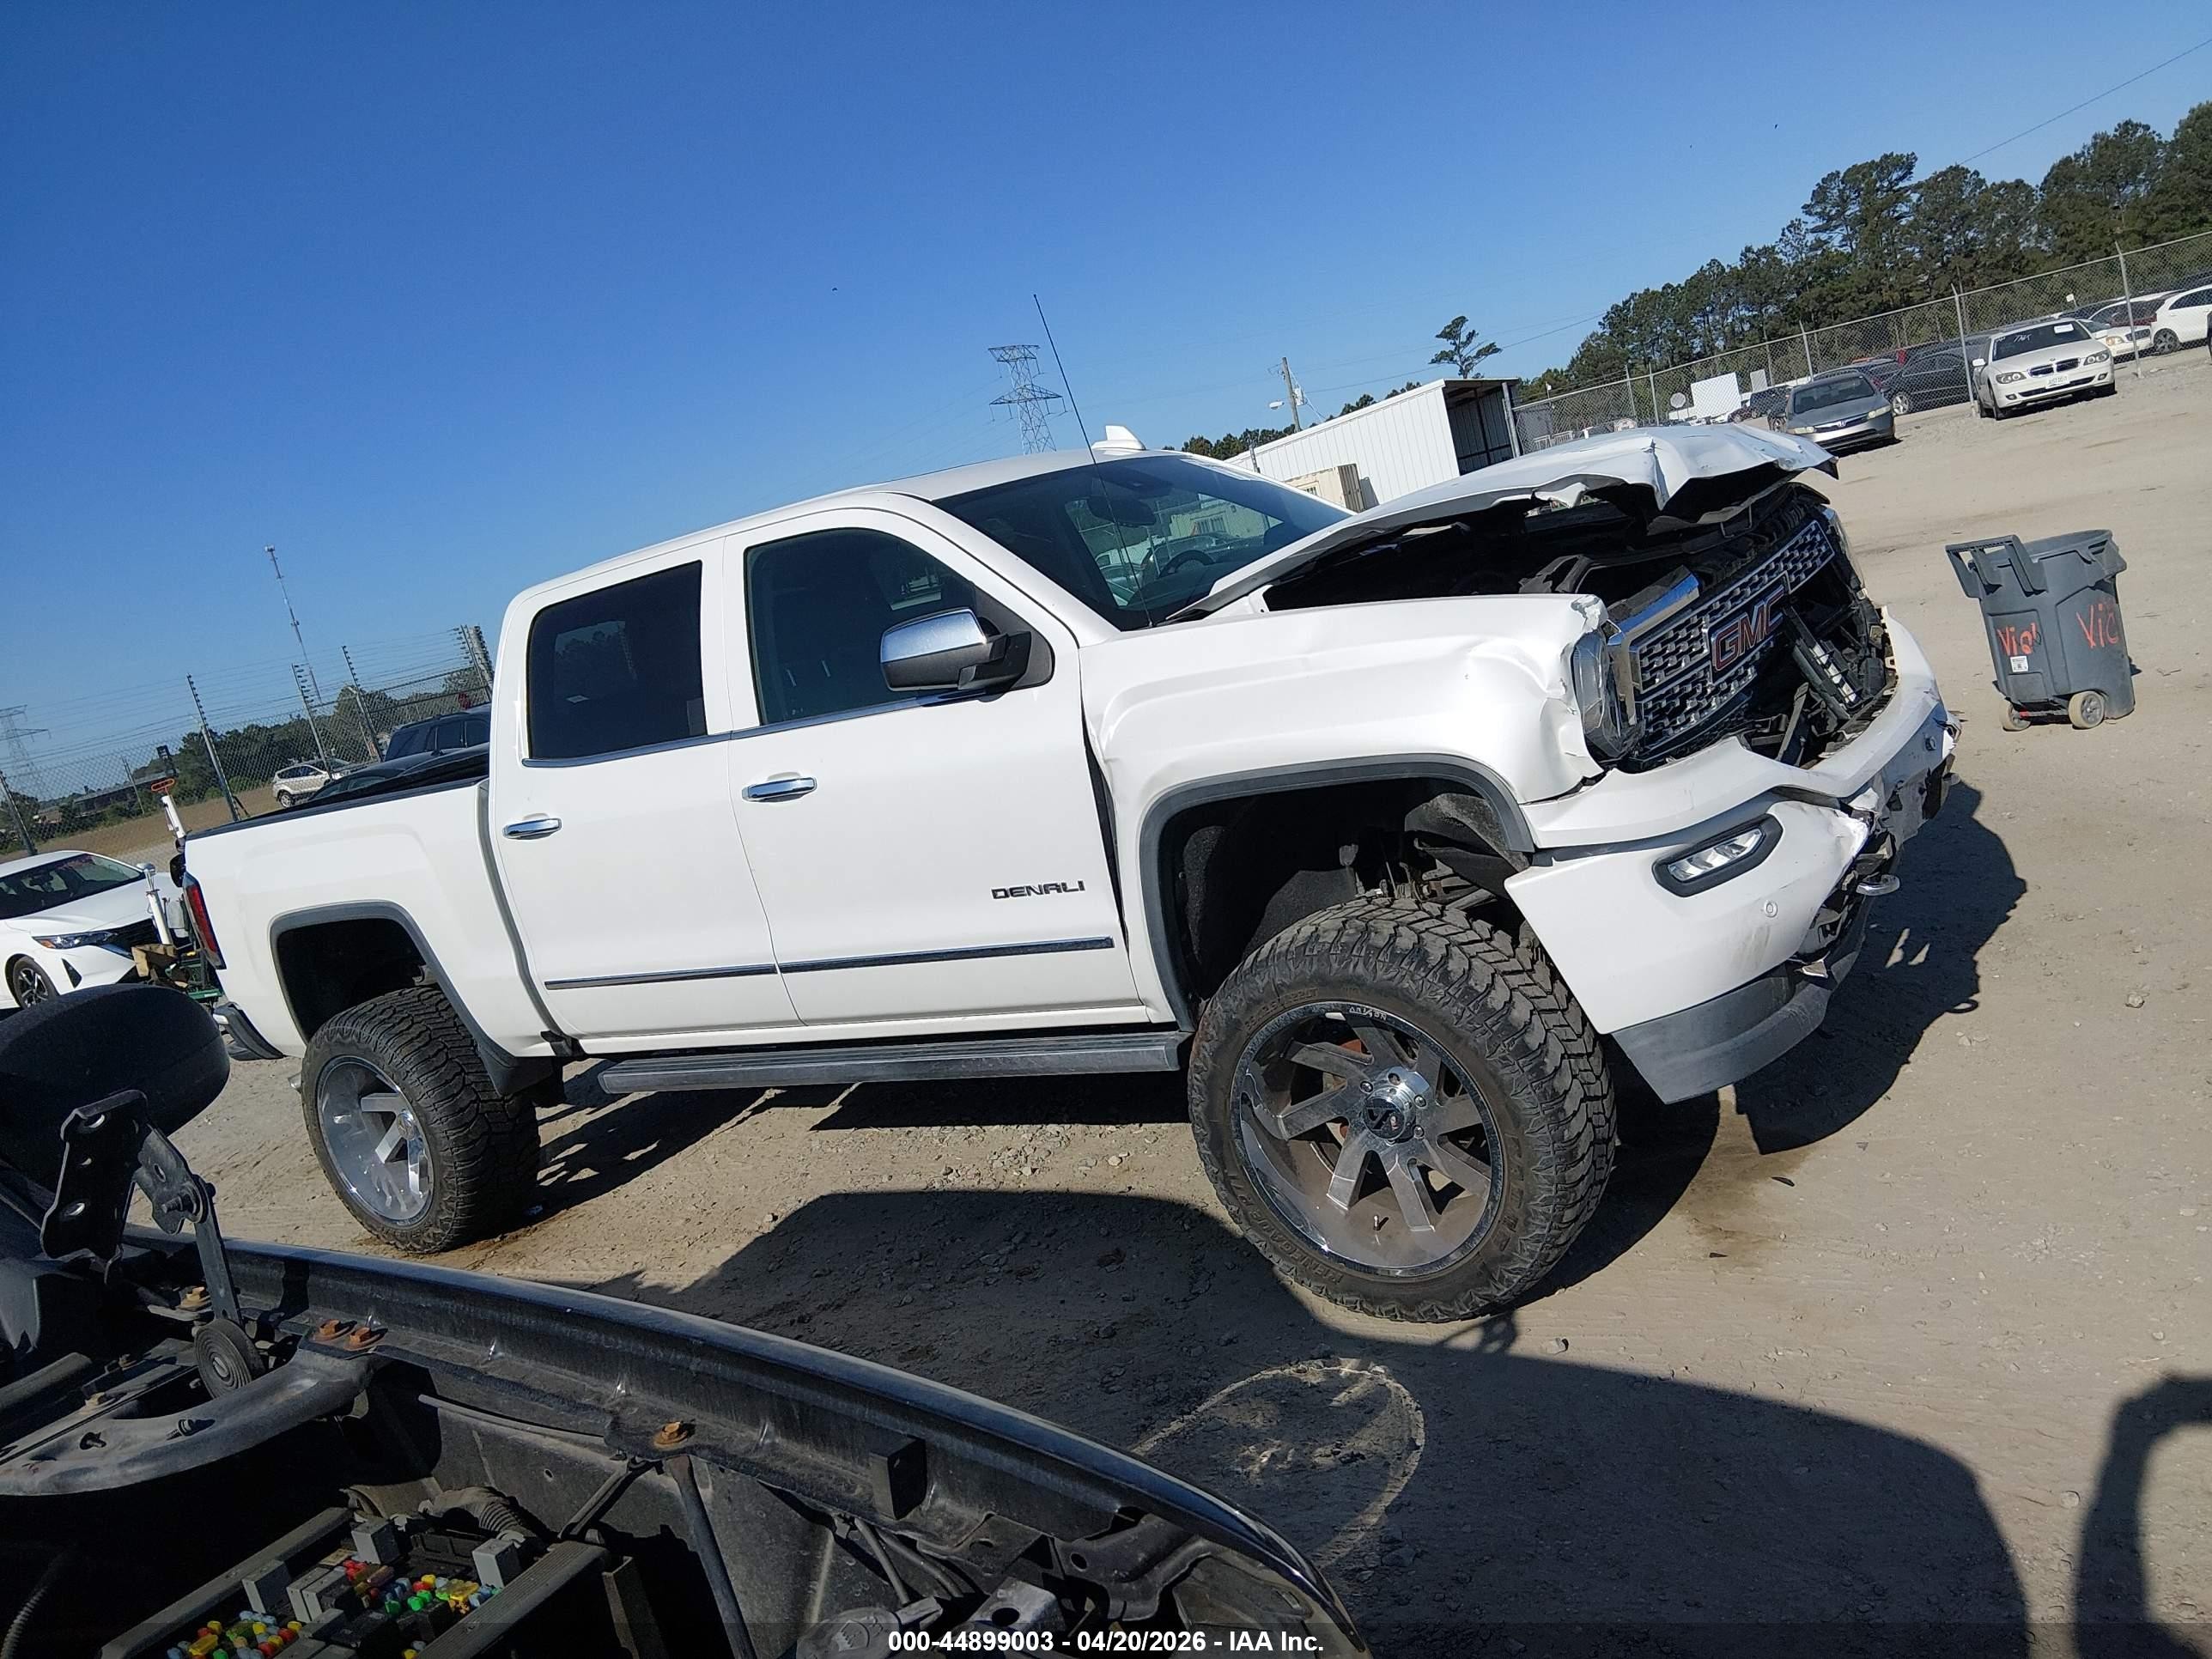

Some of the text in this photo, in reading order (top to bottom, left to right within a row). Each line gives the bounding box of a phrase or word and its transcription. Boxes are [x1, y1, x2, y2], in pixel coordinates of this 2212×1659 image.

[1711, 585, 1785, 672] GMC
[2075, 603, 2119, 649] Vic
[991, 880, 1085, 899] DENALI
